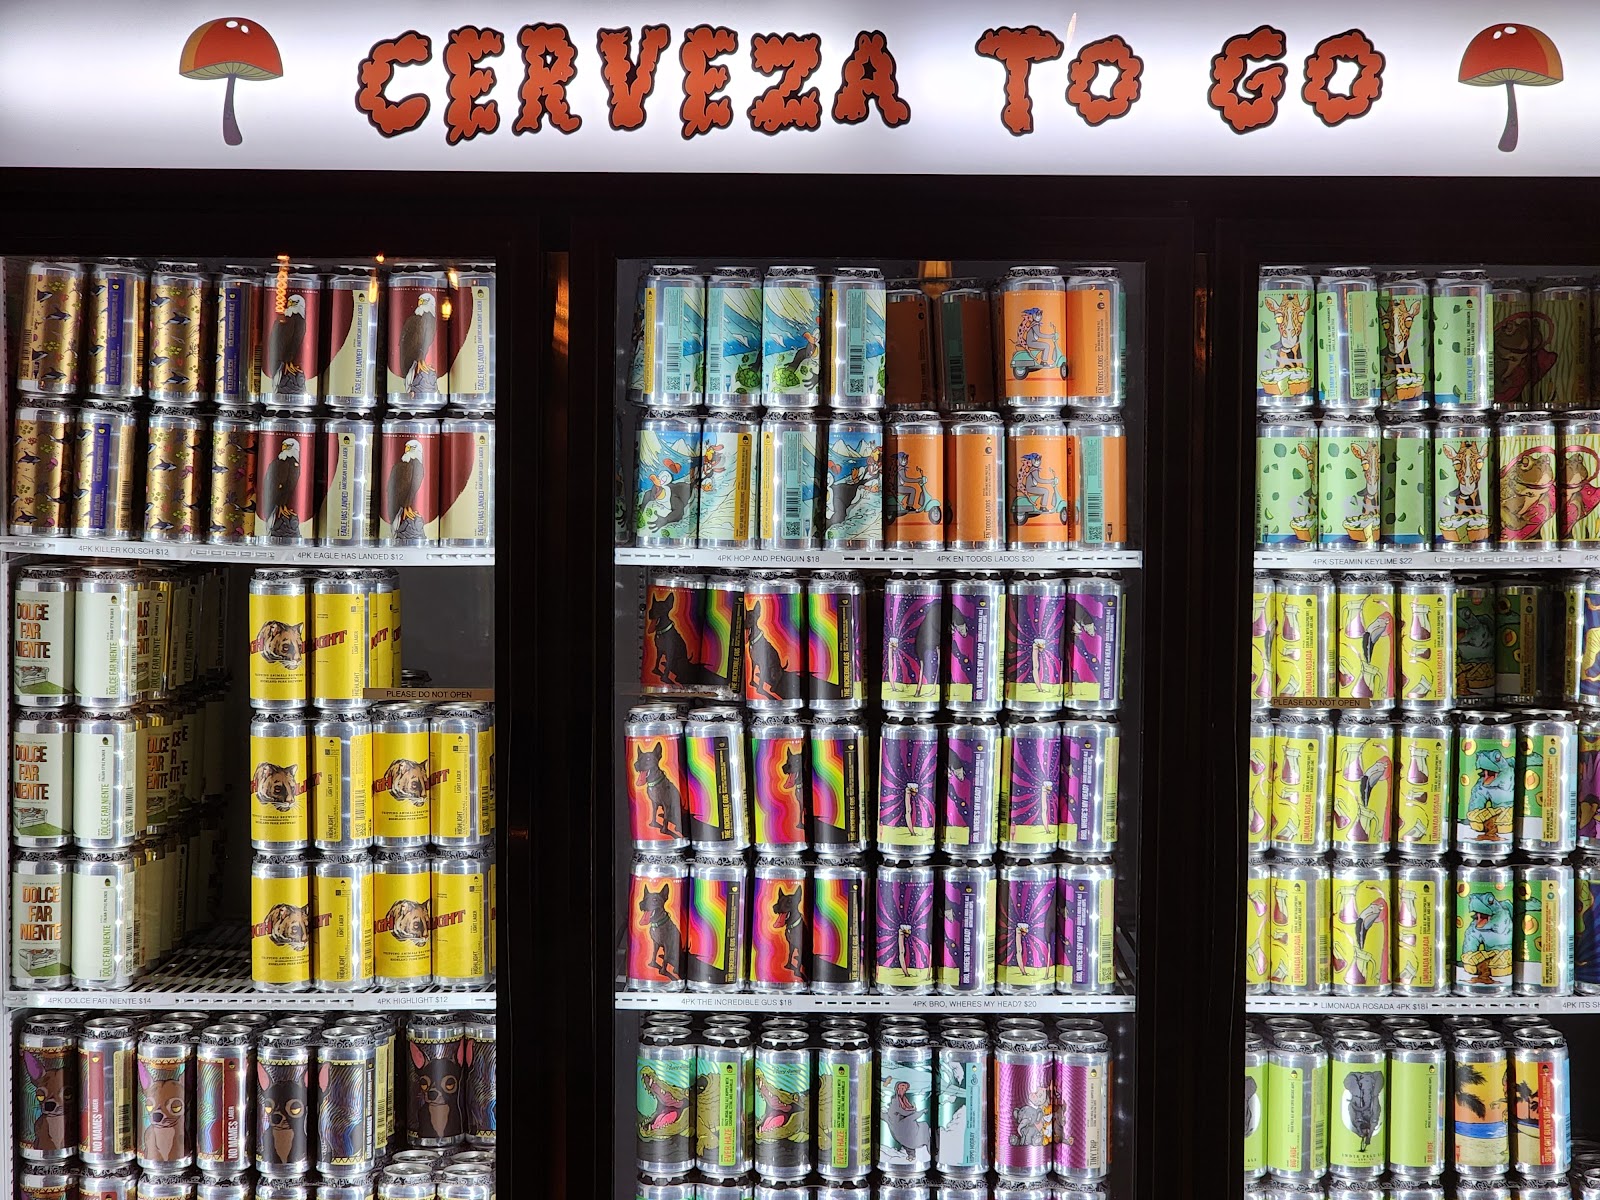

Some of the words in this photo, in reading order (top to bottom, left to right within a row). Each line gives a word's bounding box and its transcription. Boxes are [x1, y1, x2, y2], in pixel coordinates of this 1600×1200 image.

[355, 22, 911, 145] CERVEZA
[975, 26, 1144, 135] TO
[1207, 26, 1386, 133] GO
[355, 349, 363, 368] LANDED
[16, 603, 49, 621] DOLCE
[20, 622, 41, 639] FAR
[109, 642, 118, 663] NIENTE
[977, 657, 984, 665] MY
[109, 664, 117, 676] FAR
[109, 676, 117, 695] DOLCE
[976, 687, 984, 700] BRO,
[1273, 697, 1303, 705] PLEASE
[1306, 697, 1317, 706] DO
[1319, 698, 1336, 706] NOT
[1338, 698, 1361, 706] OPEN
[16, 744, 47, 762] DOLCE
[18, 764, 40, 781] FAR
[974, 787, 982, 801] HEAD?
[974, 802, 981, 810] MY
[1432, 794, 1440, 814] ROSADA
[22, 886, 60, 903] DOLCE
[28, 906, 52, 922] FAR
[20, 923, 62, 941] NIENTE
[103, 925, 111, 945] NIENTE
[102, 946, 110, 958] FAR
[102, 959, 110, 977] DOLCE
[434, 996, 448, 1004] $12
[92, 1114, 102, 1140] MAMES
[228, 1121, 238, 1147] MAMES
[724, 1128, 732, 1144] HAZE
[836, 1130, 844, 1146] HAZE
[1543, 1136, 1551, 1146] OUT
[93, 1141, 102, 1152] NO
[228, 1148, 238, 1159] NO
[724, 1145, 732, 1162] EVER
[836, 1147, 844, 1164] EVER
